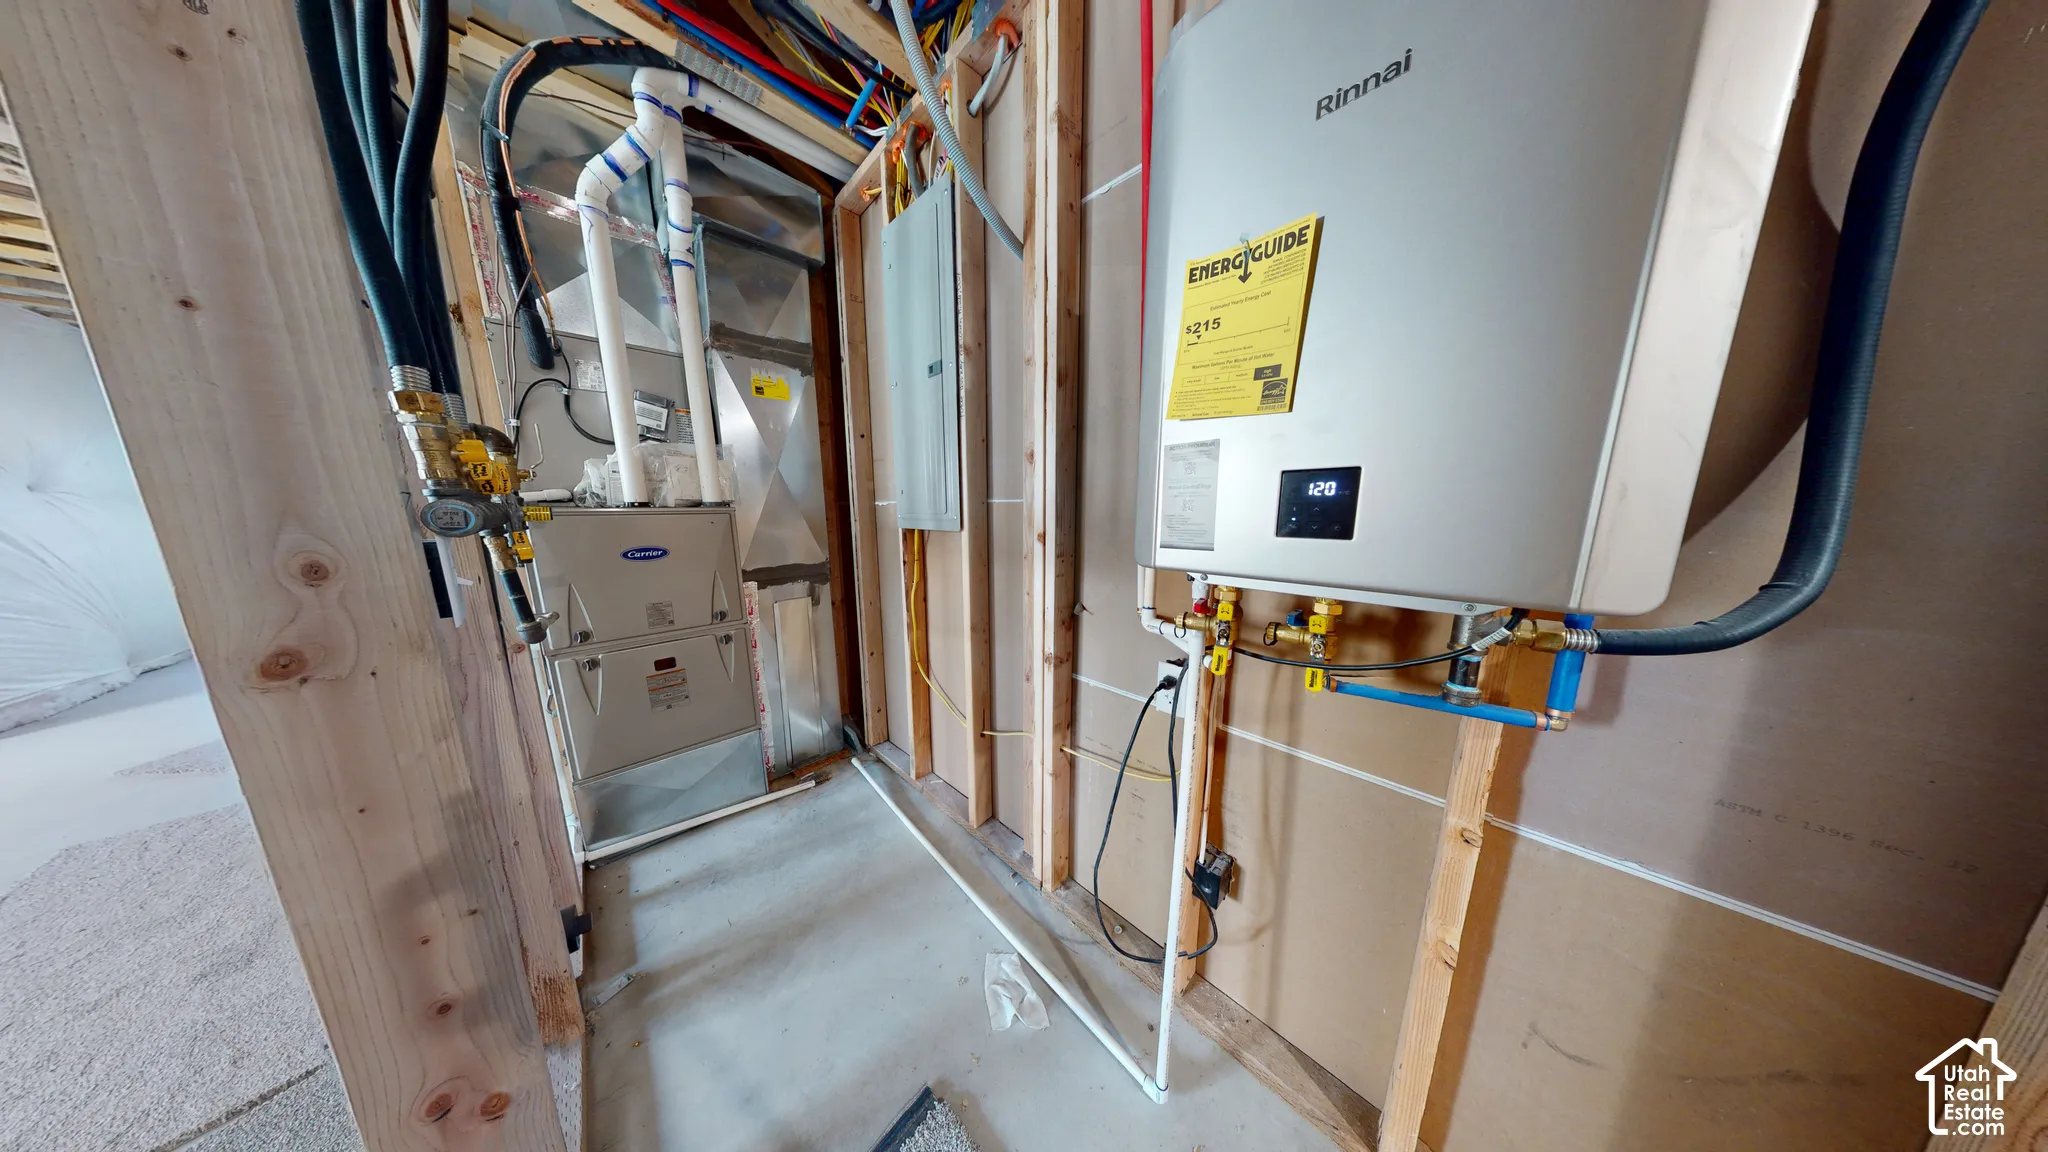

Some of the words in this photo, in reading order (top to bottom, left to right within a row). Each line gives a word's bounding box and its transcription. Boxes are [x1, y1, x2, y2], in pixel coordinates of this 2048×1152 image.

[1316, 48, 1412, 121] Rinnai
[1185, 317, 1221, 335] $215
[1308, 481, 1337, 496] 120
[627, 550, 663, 558] Carrier
[1714, 799, 1762, 817] ASTM
[1774, 814, 1789, 823] C
[1803, 821, 1855, 842] 1396
